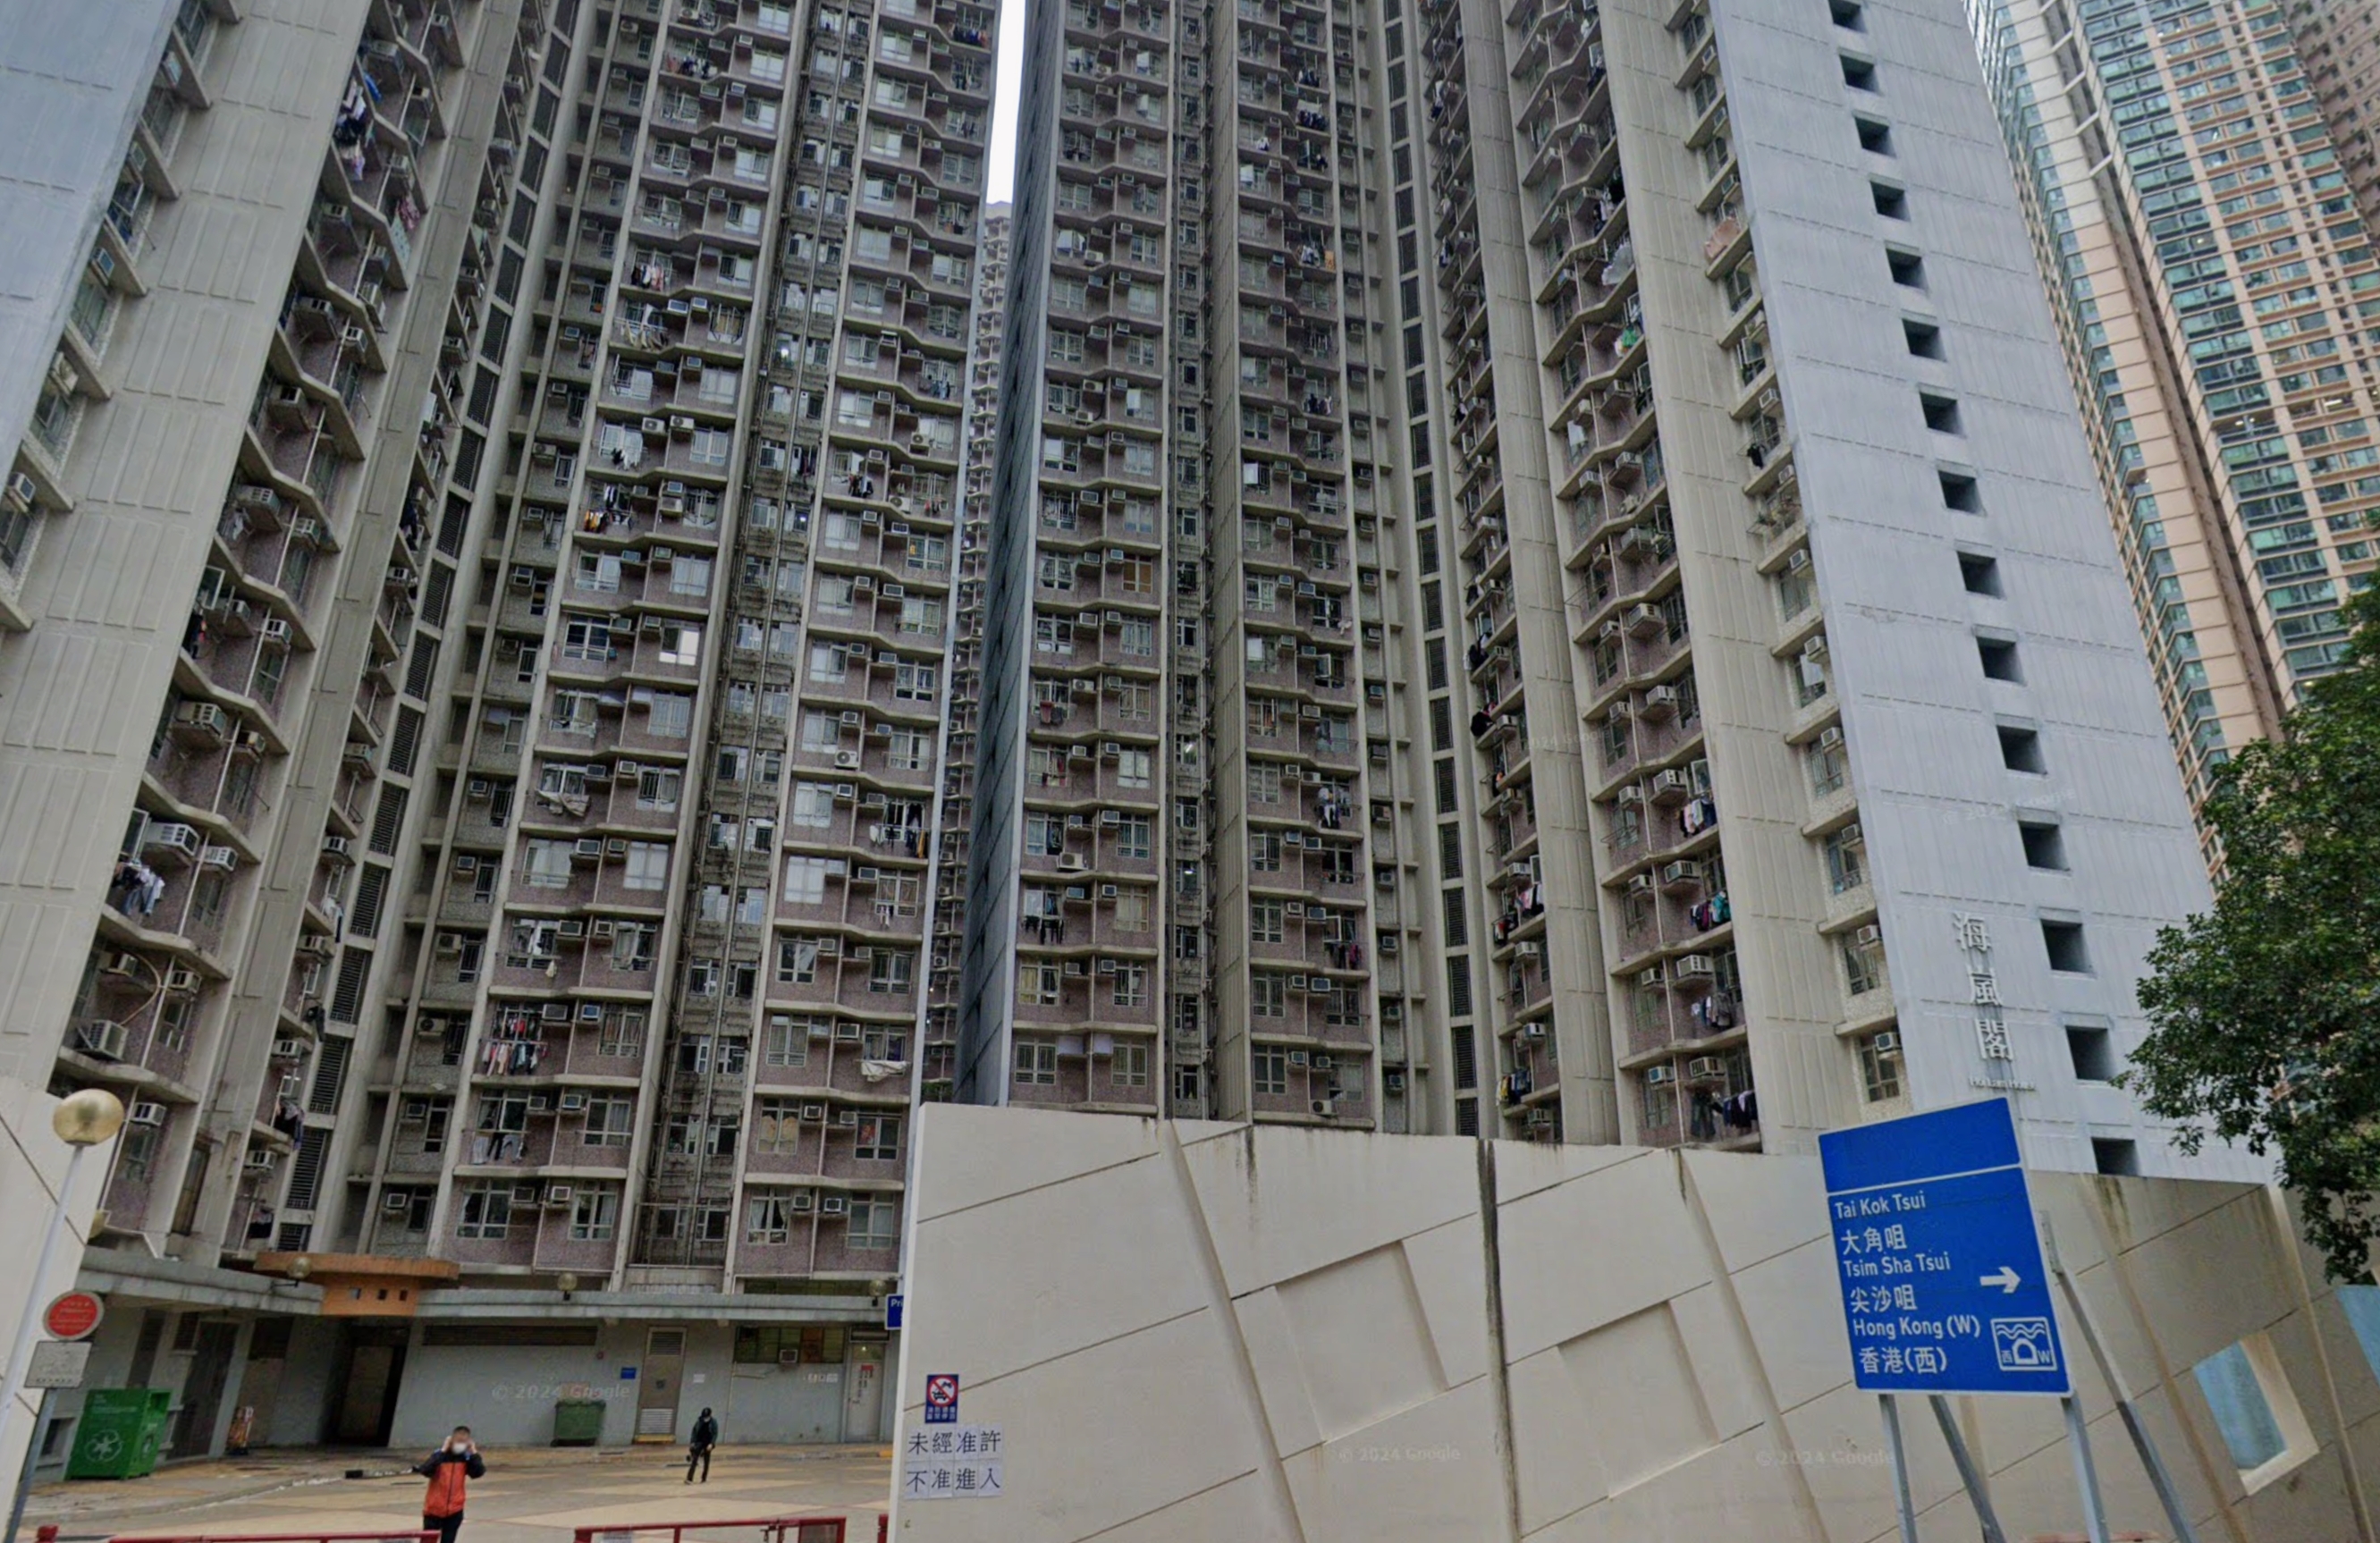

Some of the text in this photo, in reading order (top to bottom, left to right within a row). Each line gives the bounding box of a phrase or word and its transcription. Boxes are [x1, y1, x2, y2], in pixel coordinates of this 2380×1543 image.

[1835, 1190, 1926, 1219] Tai Kok Tsui
[1841, 1224, 1907, 1255] 大角咀
[1844, 1252, 1951, 1277] Tsim Sha Tsui
[1850, 1285, 1918, 1314] 尖沙咀
[1853, 1315, 1981, 1341] Hong Kong (W)
[1859, 1346, 1948, 1374] 香港(西)
[2038, 1349, 2052, 1364] W
[907, 1430, 1001, 1455] 未經准許
[906, 1467, 1000, 1493] 不准進入
